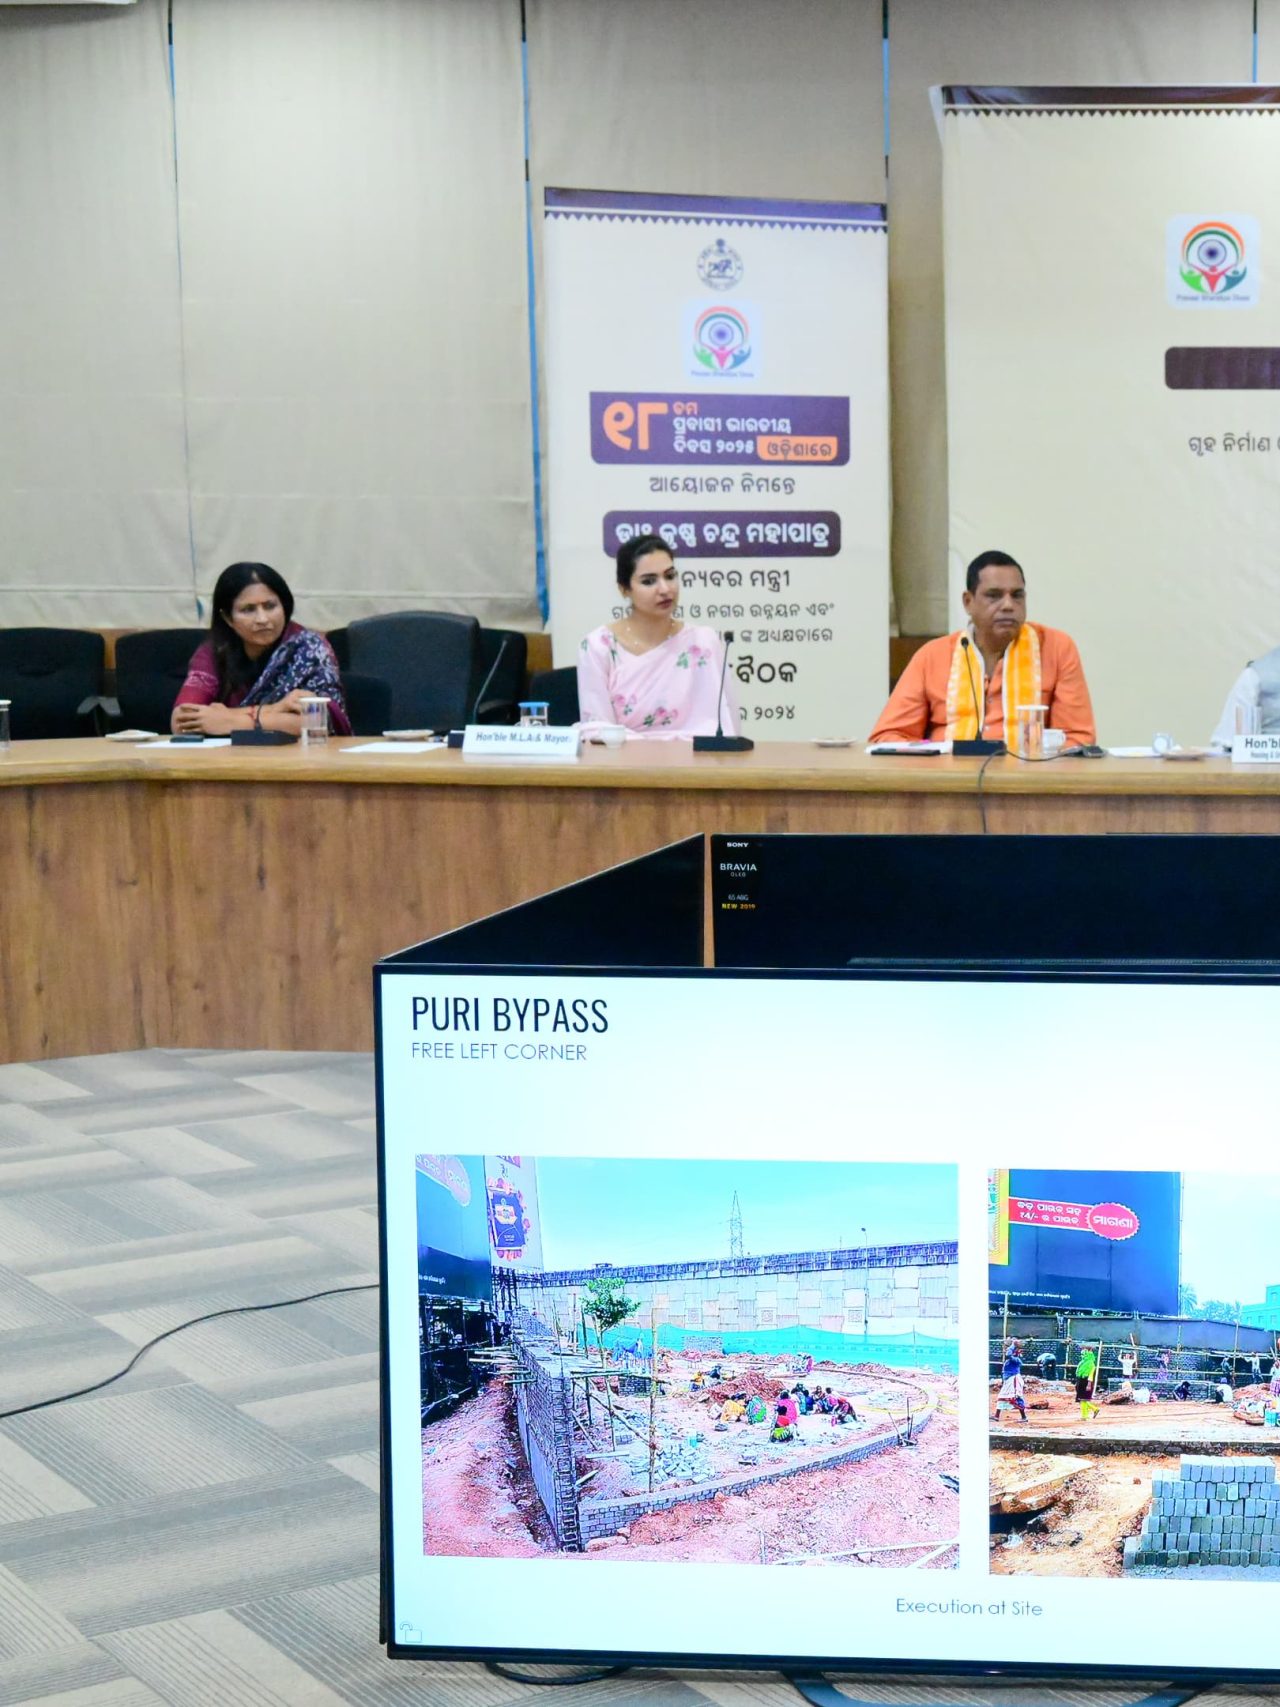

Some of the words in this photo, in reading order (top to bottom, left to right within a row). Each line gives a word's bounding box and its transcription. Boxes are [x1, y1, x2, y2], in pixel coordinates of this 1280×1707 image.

[1188, 437, 1217, 457] ଗୃହ
[1223, 433, 1271, 452] ନିର୍ମାଣ
[649, 476, 735, 494] ଆୟୋଜନ
[741, 473, 796, 495] ନିମନ୍ତେ
[703, 523, 740, 547] ଚନ୍ଦ୍ର
[746, 523, 830, 547] ମହାପାତ୍ର
[749, 569, 791, 592] ମନ୍ତ୍ରୀ
[707, 605, 744, 618] ନଗର
[754, 705, 795, 721] ୨୦୨୪
[719, 863, 757, 871] BRAVIA
[411, 996, 479, 1031] PURI
[493, 998, 608, 1033] BYPASS
[412, 1043, 454, 1059] FREE
[461, 1043, 498, 1060] LEFT
[504, 1043, 587, 1061] CORNER
[896, 1598, 982, 1614] Execution
[988, 1600, 1006, 1615] at
[1011, 1600, 1043, 1616] Site
